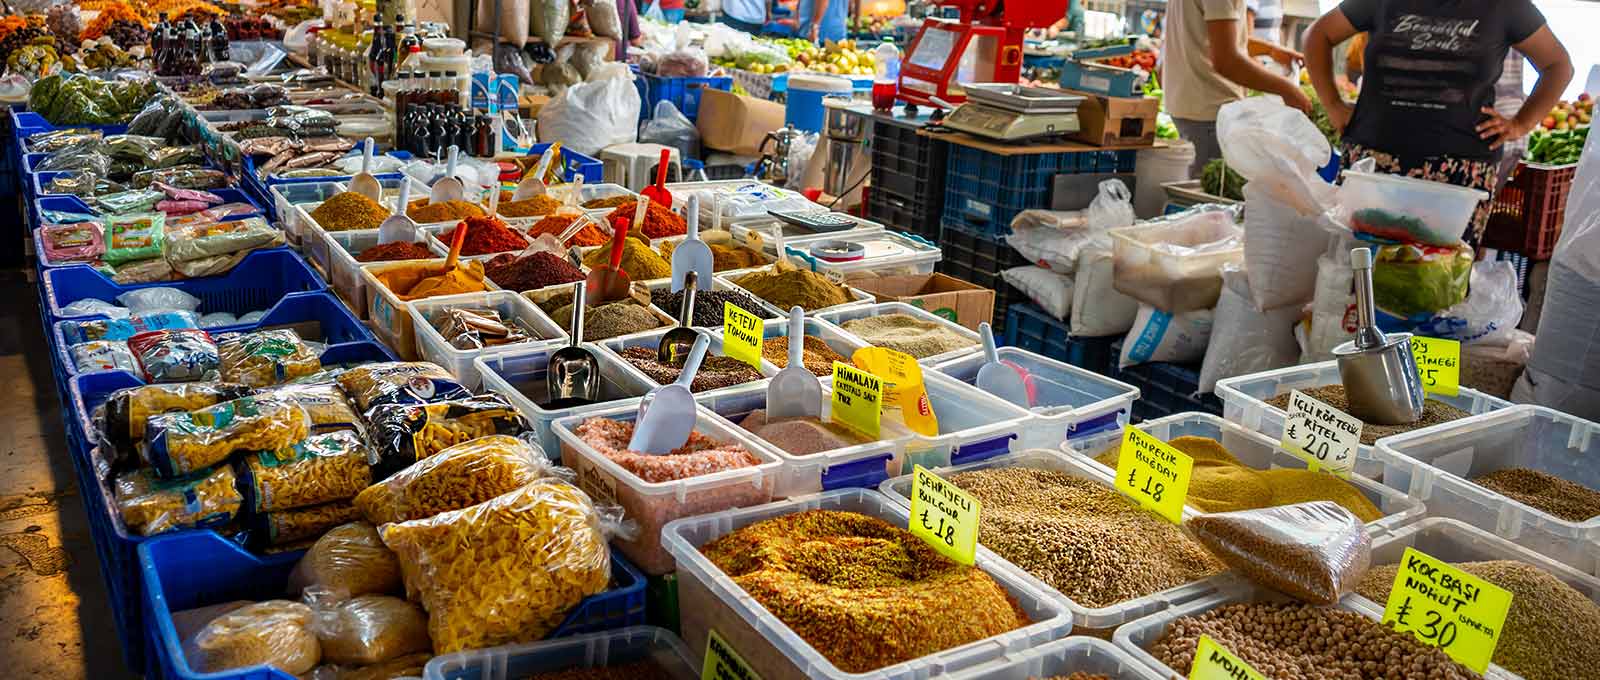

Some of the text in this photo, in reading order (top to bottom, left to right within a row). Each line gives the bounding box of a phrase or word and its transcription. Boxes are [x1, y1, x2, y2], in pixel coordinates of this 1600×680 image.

[1393, 14, 1480, 37] Beautiful
[1411, 32, 1461, 51] Souls
[729, 309, 757, 331] KETEN
[727, 323, 758, 346] TOHUMU
[837, 366, 880, 392] HİMALAYA
[836, 392, 852, 406] TUZ
[919, 487, 961, 524] BULGUR
[1405, 576, 1467, 613] NOHUT
